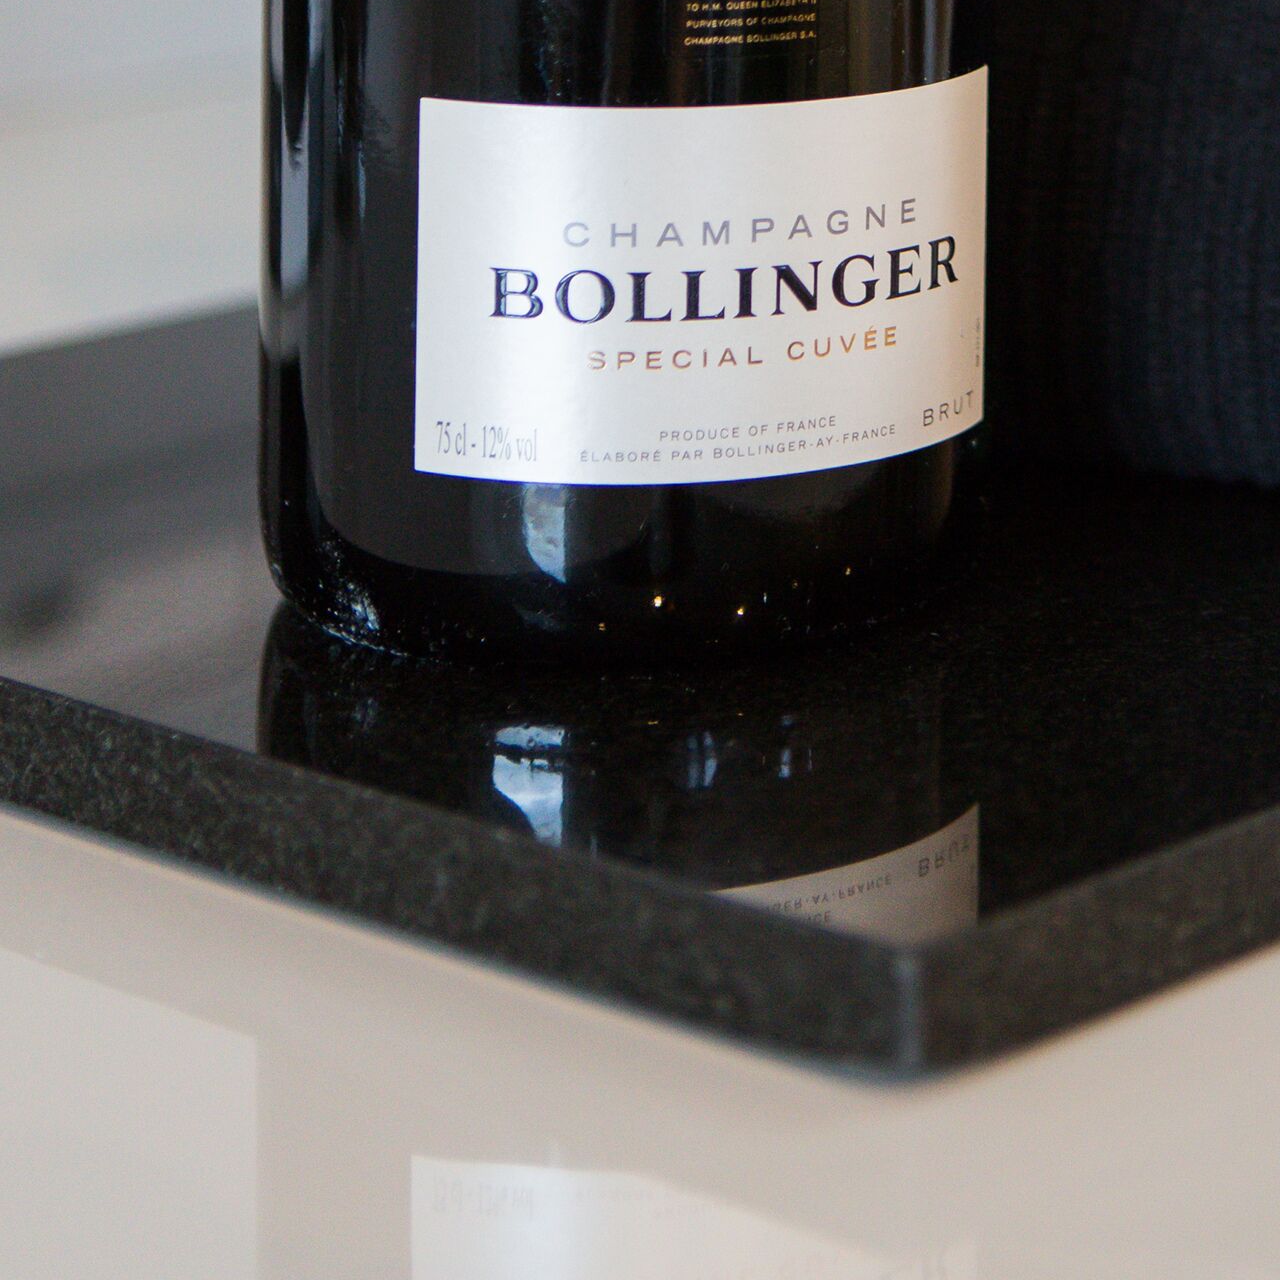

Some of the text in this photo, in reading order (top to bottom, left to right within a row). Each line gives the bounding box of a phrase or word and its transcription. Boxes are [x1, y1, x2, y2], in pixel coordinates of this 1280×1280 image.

[686, 2, 700, 12] TO
[726, 0, 758, 10] QUEEN
[686, 13, 816, 29] PURVEYORS OF CHAMPAGNE
[683, 34, 744, 46] CHAMPAGNE
[746, 31, 798, 43] BOLLINGER
[562, 197, 918, 249] CHAMPAGNE
[488, 235, 960, 325] BOLLINGER
[587, 325, 898, 372] SPECIAL CUVÉE
[923, 390, 974, 427] BRUT
[436, 420, 451, 454] 75
[455, 422, 466, 456] cl
[482, 425, 512, 461] 12%
[516, 427, 538, 462] vol
[659, 415, 837, 442] PRODUCE OF FRANCE
[580, 450, 662, 464] ÉLABORÉ
[671, 449, 704, 462] PAR
